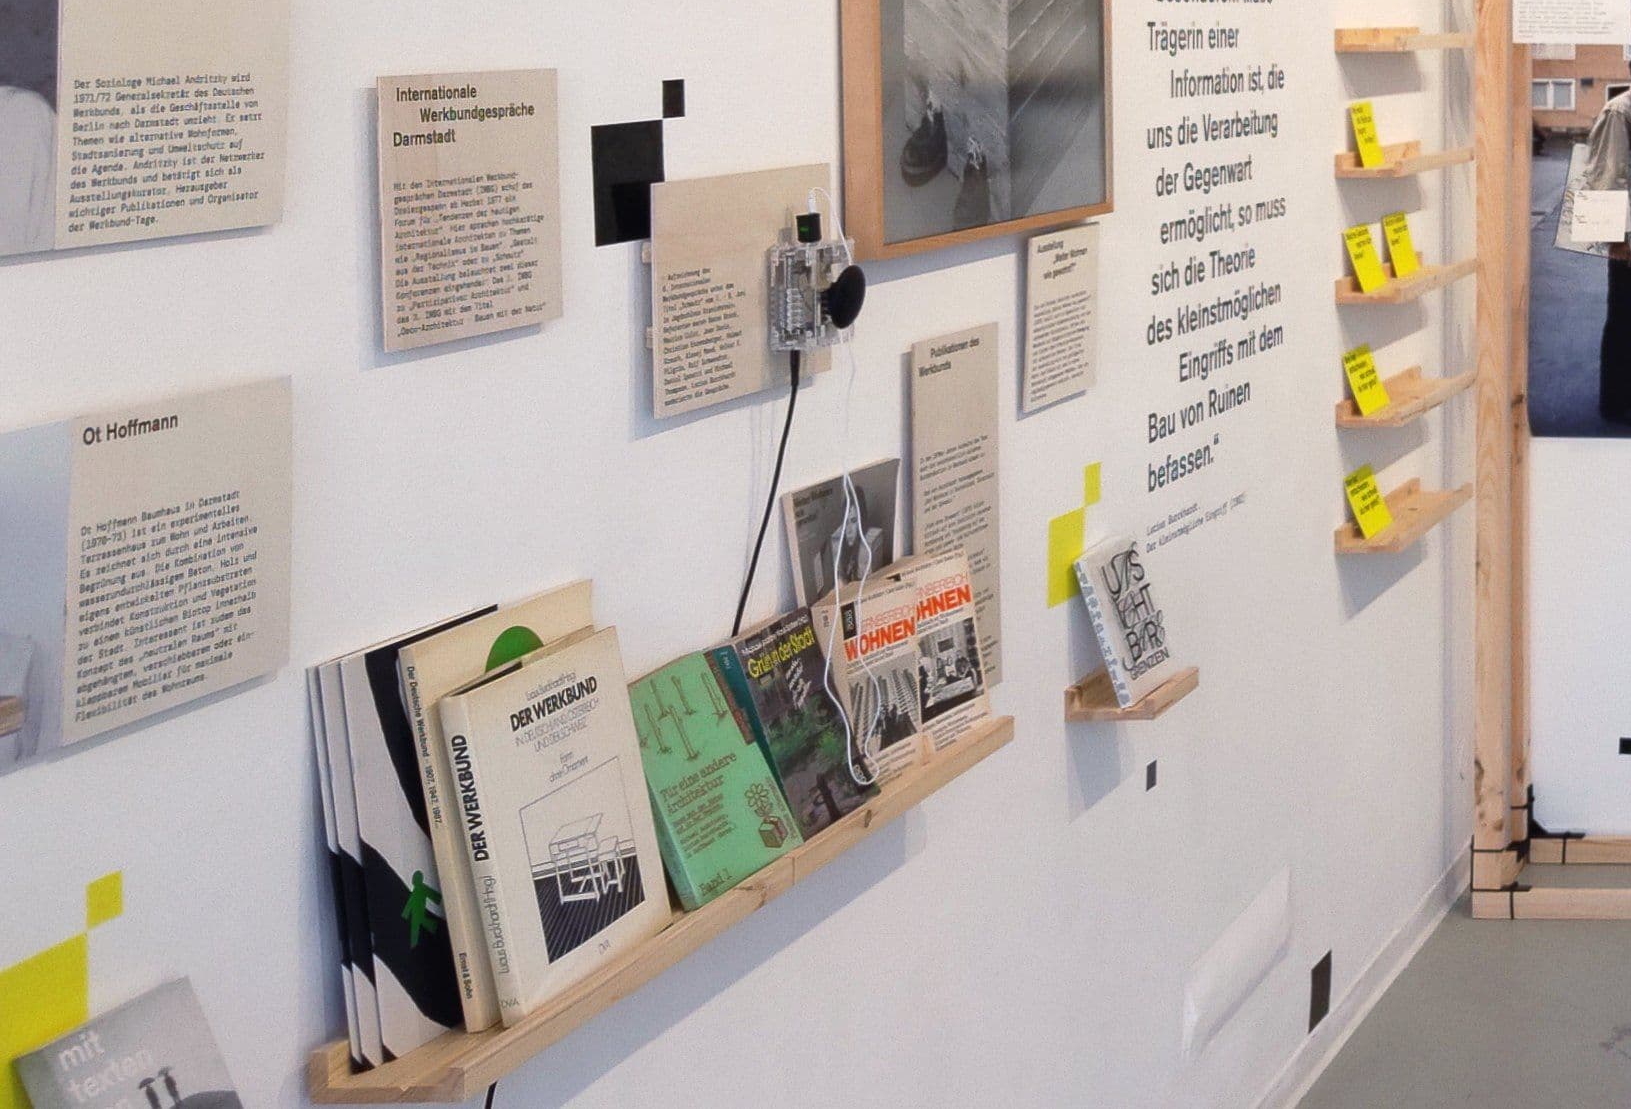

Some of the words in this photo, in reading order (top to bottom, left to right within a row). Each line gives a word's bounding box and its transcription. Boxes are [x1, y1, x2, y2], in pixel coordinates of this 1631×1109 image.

[1148, 21, 1203, 56] Trägerin
[1208, 21, 1239, 49] einer
[396, 84, 477, 102] Internationale
[1170, 66, 1244, 98] Information
[1248, 65, 1264, 94] ist,
[1268, 63, 1284, 90] die
[420, 102, 535, 124] Werkbundgespräche
[1147, 124, 1172, 149] uns
[1178, 116, 1198, 145] die
[1203, 110, 1278, 142] Verarbeitung
[393, 129, 456, 147] Darmstadt
[1156, 167, 1178, 196] der
[1183, 154, 1252, 194] Gegenwart
[1160, 203, 1235, 244] ermöglicht,
[1238, 204, 1251, 227] so
[1256, 197, 1286, 221] muss
[1151, 261, 1180, 296] sich
[1184, 256, 1206, 287] die
[1209, 243, 1256, 279] Theorie
[1147, 315, 1173, 346] des
[1177, 282, 1281, 336] kleinstmöglichen
[1180, 339, 1234, 383] Eingriffs
[1238, 329, 1256, 360] mit
[1259, 325, 1283, 354] dem
[83, 427, 102, 445] Ot
[107, 414, 178, 441] Hoffmann
[1148, 413, 1176, 443] Bau
[1180, 400, 1204, 430] von
[1209, 381, 1251, 418] Ruinen
[1148, 434, 1220, 493] befassen.“
[844, 617, 916, 661] WOHNEN
[410, 682, 421, 718] Deutsche
[510, 707, 534, 731] DER
[532, 676, 597, 719] WERKBUND
[415, 718, 430, 757] Werkbund
[452, 735, 484, 830] WERKBUND
[471, 830, 490, 861] DER
[58, 1030, 104, 1072] mit
